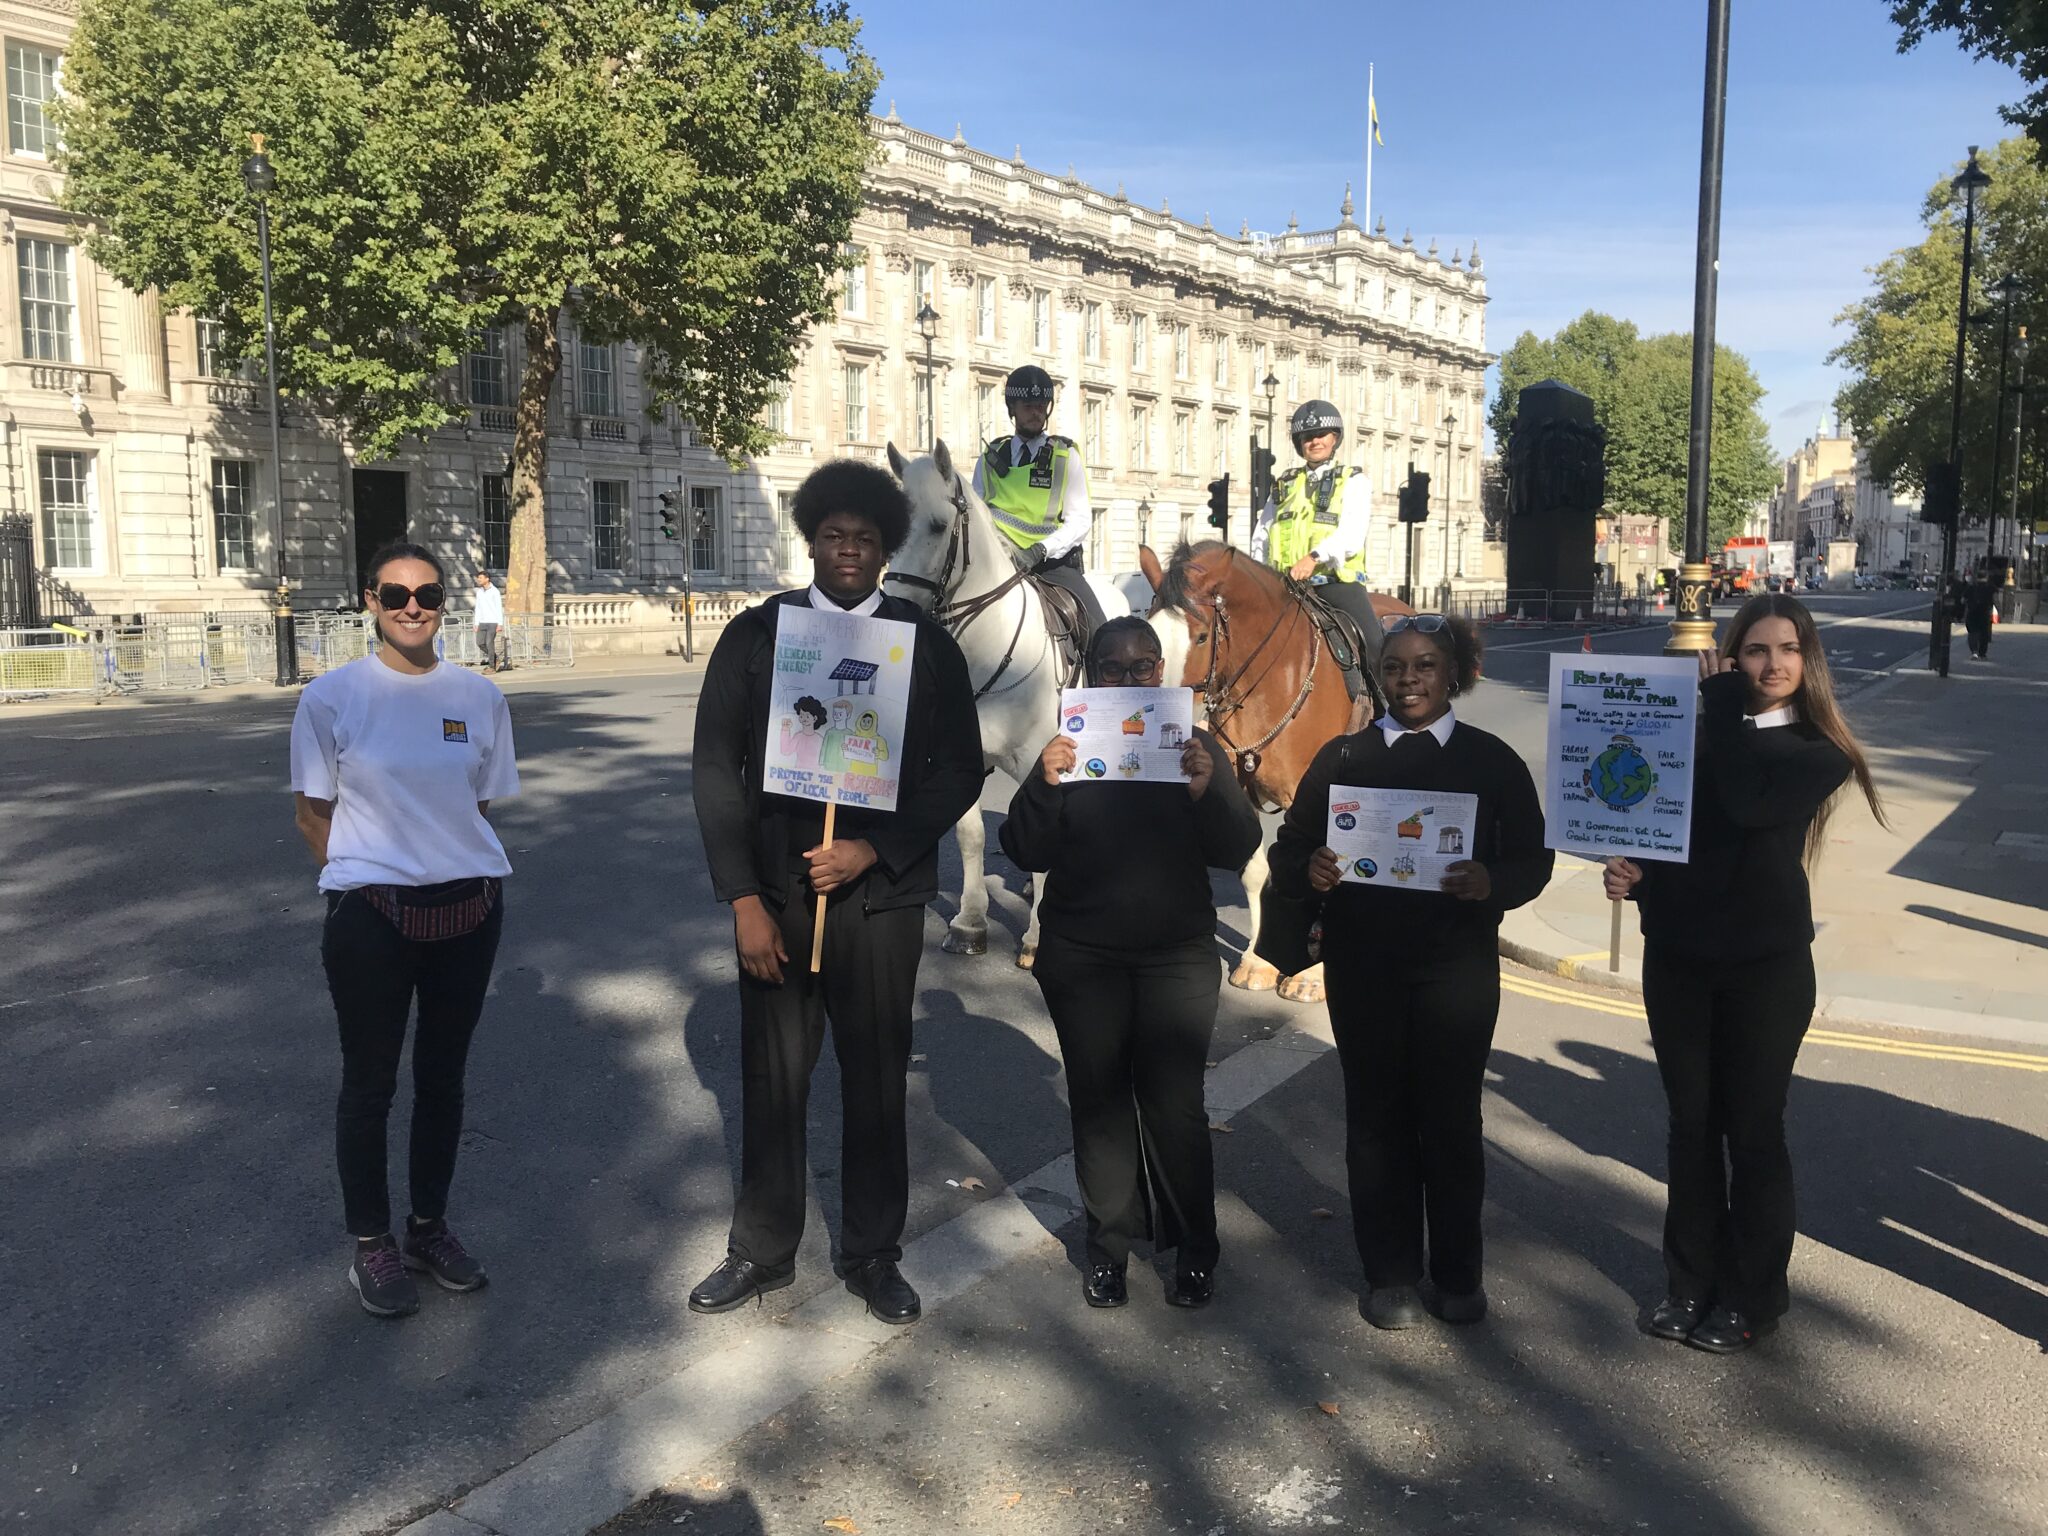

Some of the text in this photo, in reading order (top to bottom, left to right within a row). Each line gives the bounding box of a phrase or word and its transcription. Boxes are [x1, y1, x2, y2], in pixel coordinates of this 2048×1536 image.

[776, 660, 814, 674] ENERGY
[1658, 751, 1675, 759] FAIR
[769, 766, 813, 781] PROTECT
[784, 780, 801, 793] OF
[1568, 819, 1580, 828] UK
